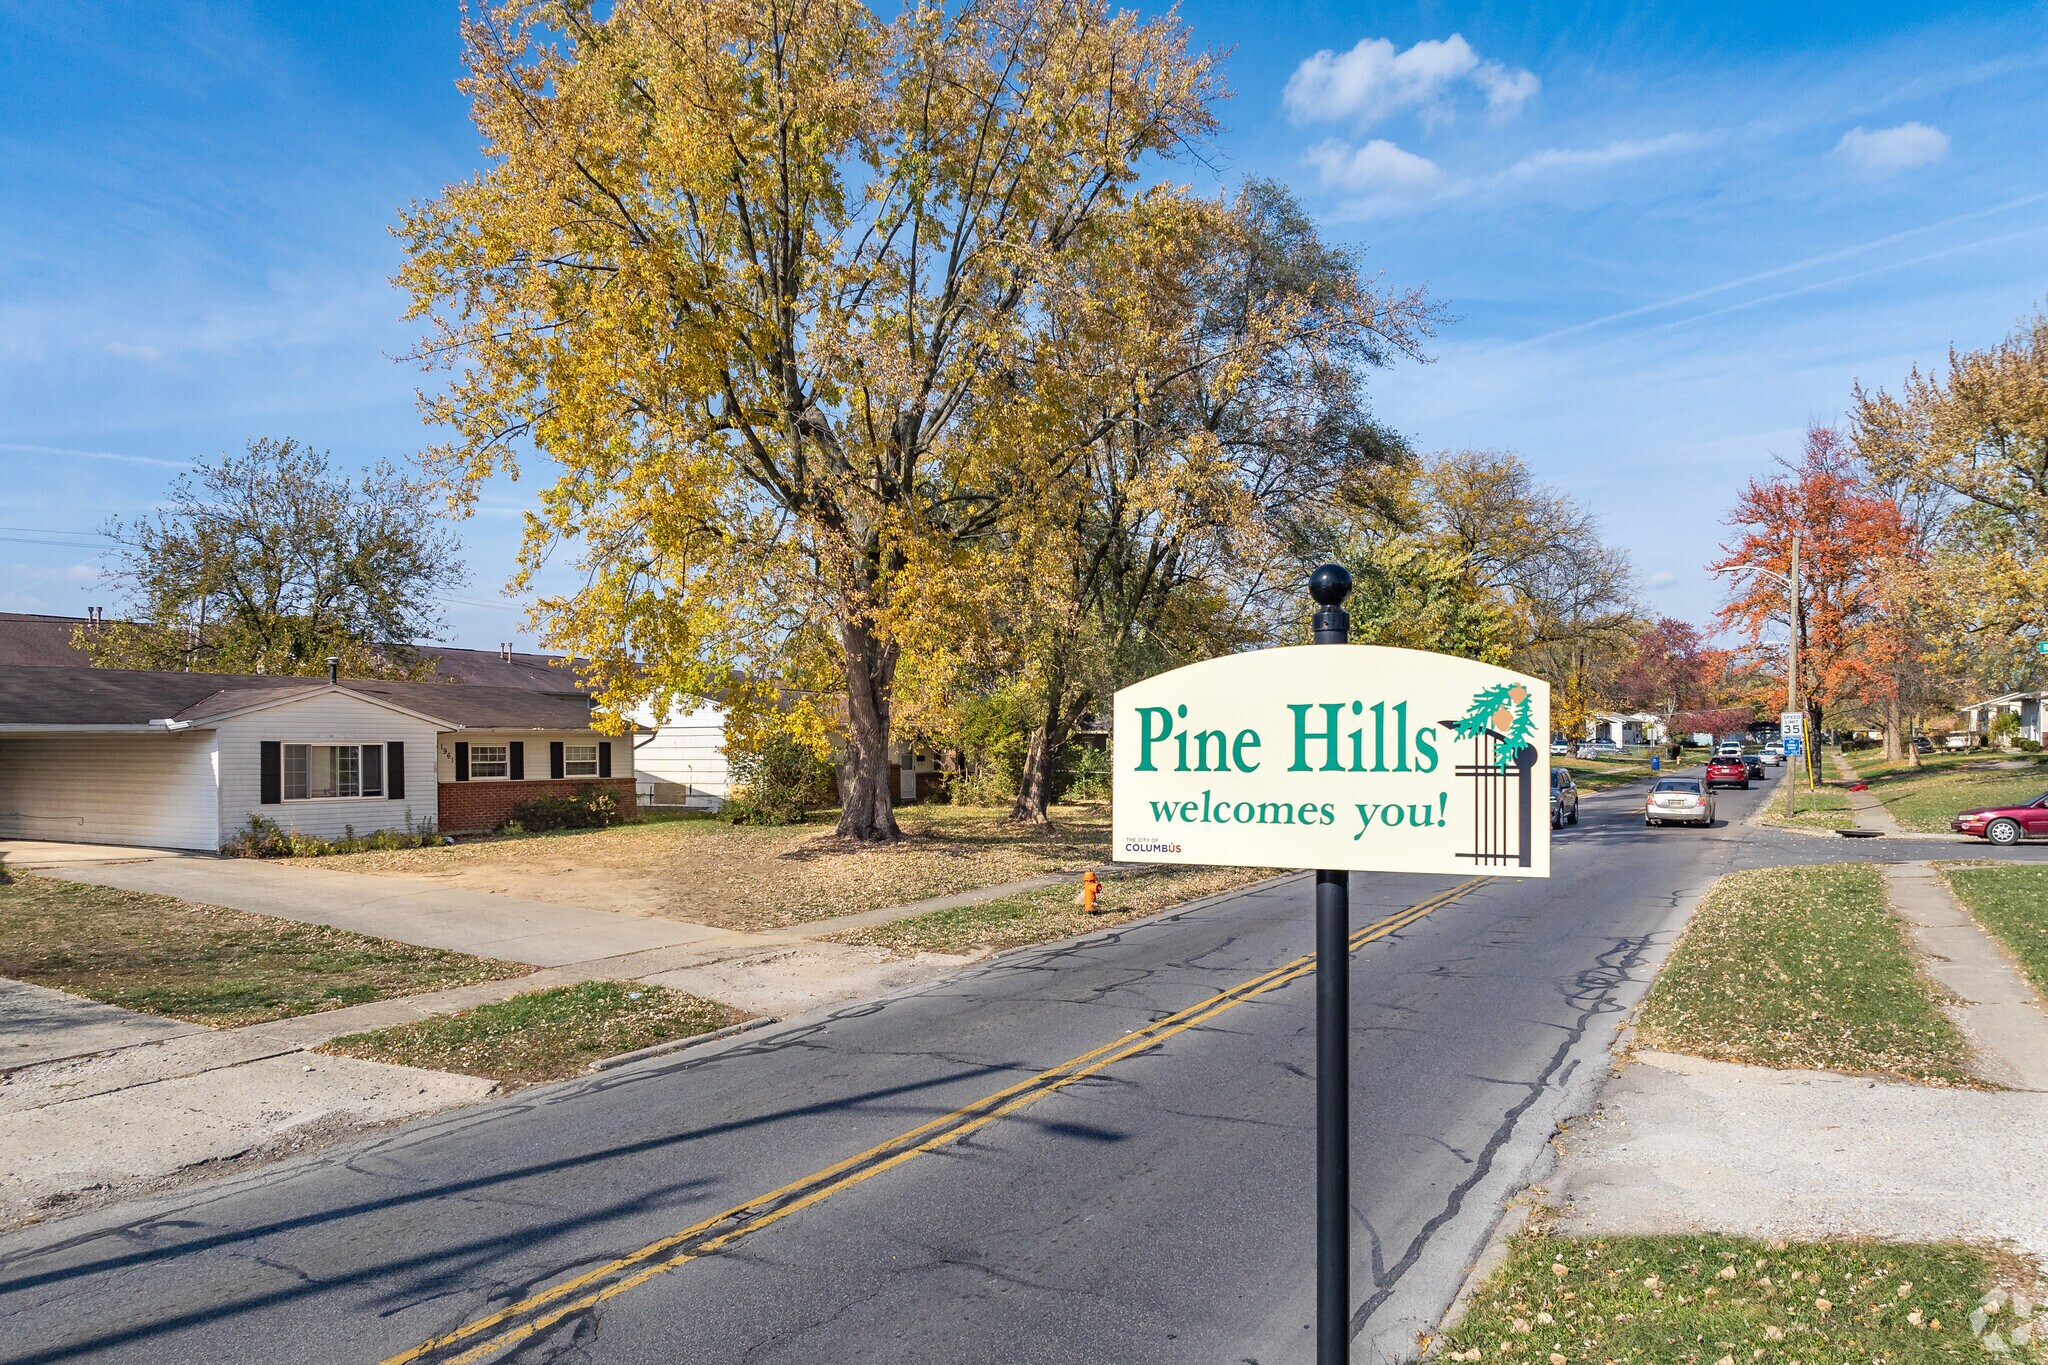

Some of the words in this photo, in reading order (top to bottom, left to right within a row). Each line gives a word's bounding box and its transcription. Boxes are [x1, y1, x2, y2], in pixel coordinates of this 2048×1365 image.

[1134, 704, 1261, 773] Pine
[1287, 700, 1439, 773] Hills
[1784, 725, 1800, 734] 35
[440, 744, 454, 763] 1961
[1149, 789, 1334, 825] welcomes
[1354, 792, 1447, 840] you!
[1125, 843, 1182, 853] COLUMBUS
